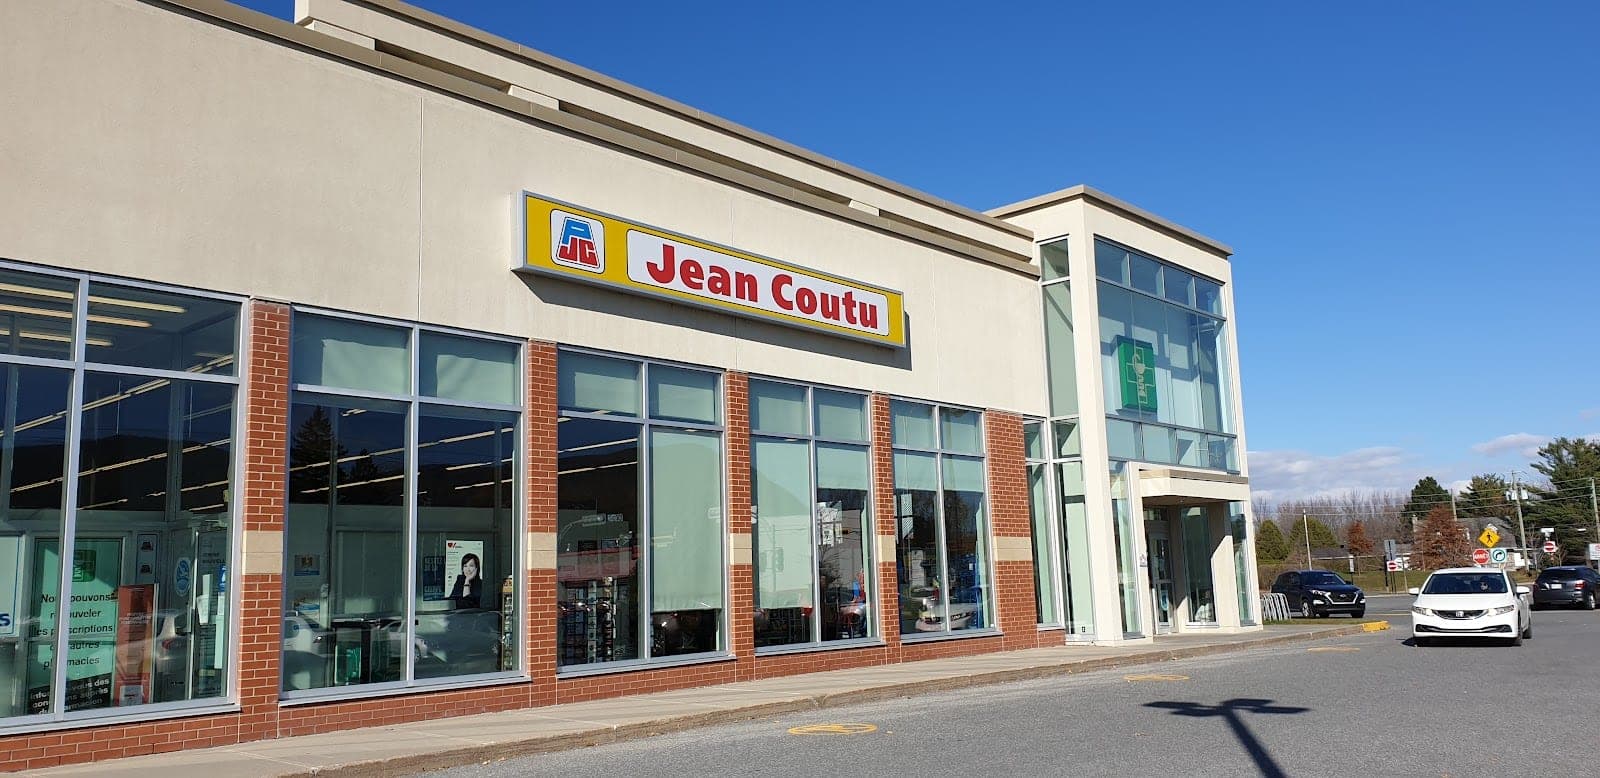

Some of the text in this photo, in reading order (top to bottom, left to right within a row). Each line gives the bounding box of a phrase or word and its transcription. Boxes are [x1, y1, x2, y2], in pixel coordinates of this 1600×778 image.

[558, 217, 600, 268] PJC
[646, 243, 879, 330] Jean Coutu
[70, 594, 110, 603] pouvons
[50, 608, 102, 619] ruveler
[51, 624, 113, 636] pscriptions
[43, 657, 100, 671] pmacies
